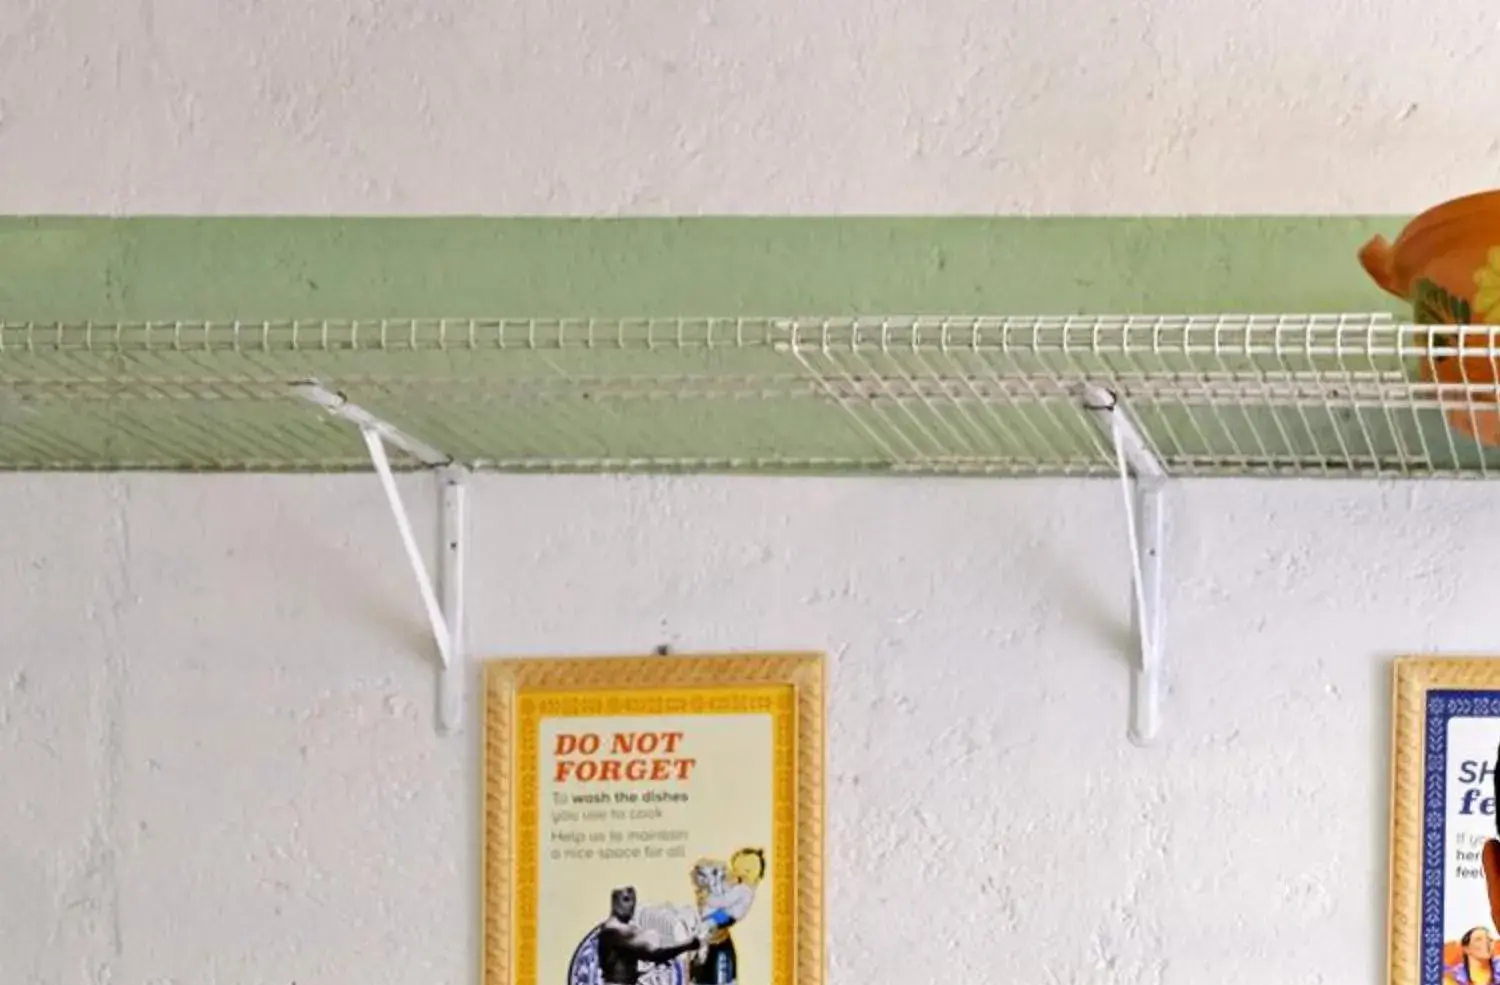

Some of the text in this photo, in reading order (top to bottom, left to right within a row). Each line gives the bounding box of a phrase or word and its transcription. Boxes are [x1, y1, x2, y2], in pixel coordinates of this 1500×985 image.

[553, 732, 684, 755] DO NOT
[553, 758, 696, 782] FORGET
[552, 790, 689, 804] To wash the dishes
[551, 810, 579, 825] you
[582, 810, 607, 821] use
[611, 808, 625, 820] to
[551, 830, 689, 846] Help us to maintain
[550, 849, 561, 859] a
[563, 848, 594, 859] nice
[598, 847, 641, 861] space
[644, 846, 663, 858] for
